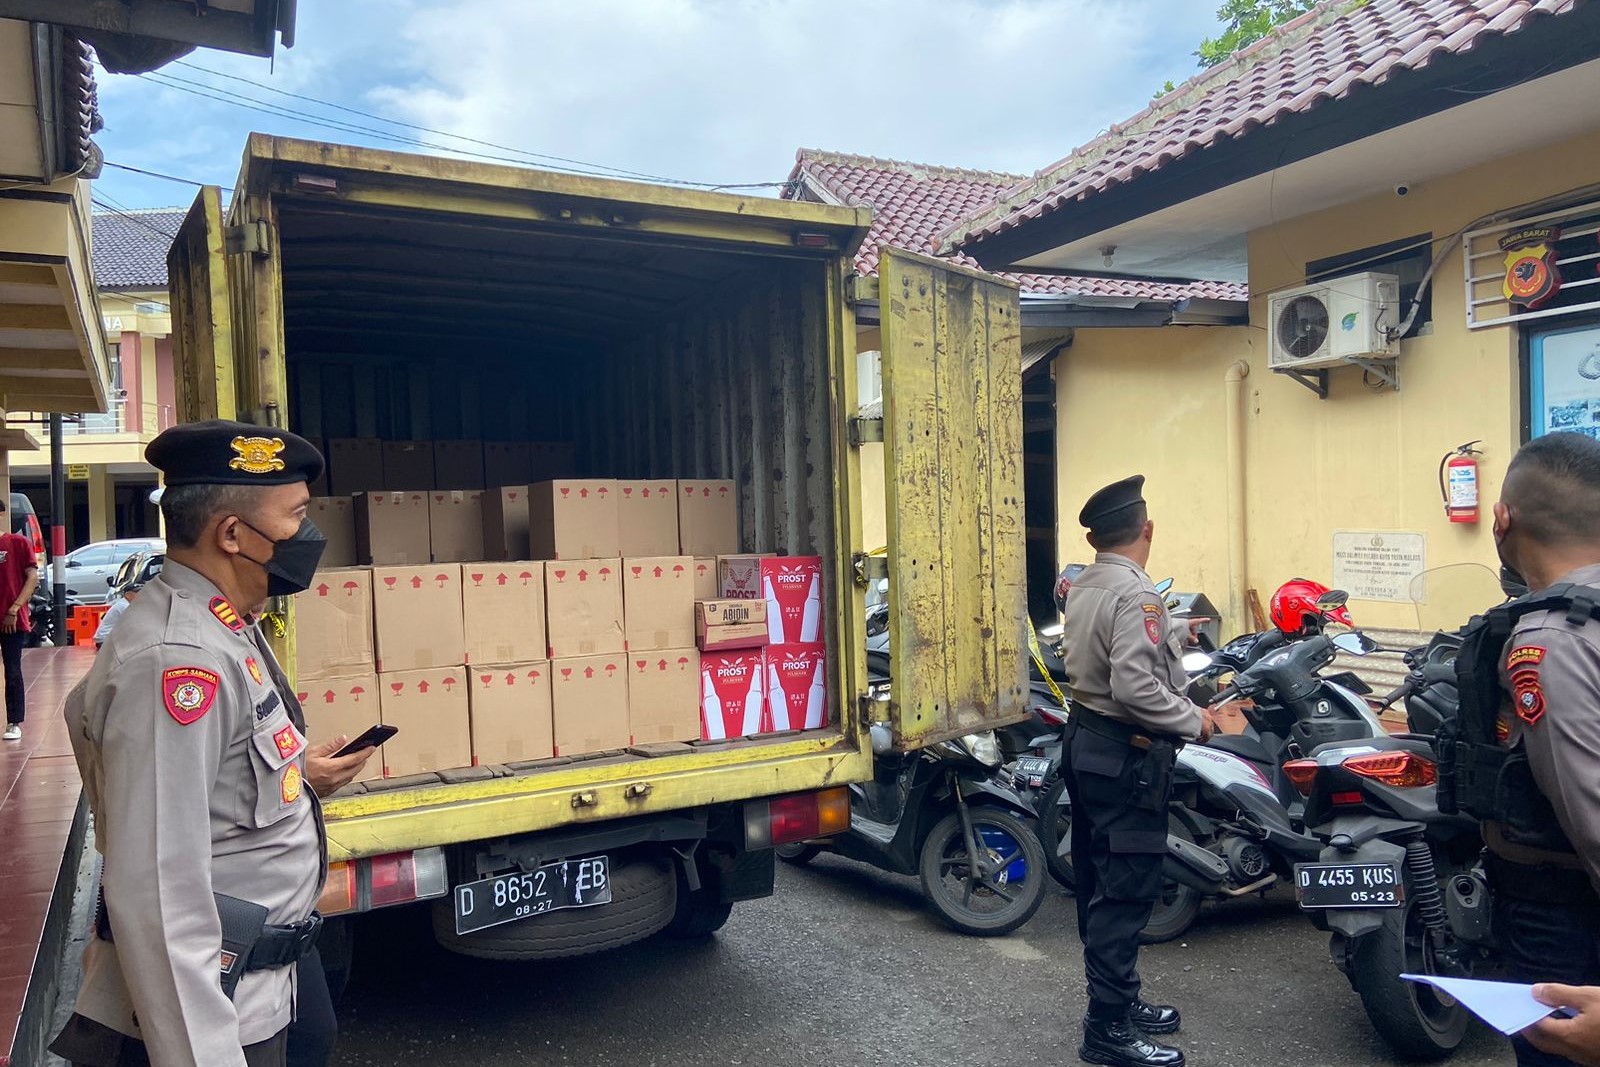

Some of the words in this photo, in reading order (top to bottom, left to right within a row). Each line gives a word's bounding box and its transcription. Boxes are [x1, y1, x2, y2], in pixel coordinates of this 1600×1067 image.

[1523, 229, 1550, 237] BARAT
[777, 574, 806, 583] PROST
[723, 607, 749, 621] ABIDIN
[782, 660, 811, 670] PROST
[717, 666, 748, 677] PROST
[1301, 871, 1310, 887] D
[1318, 869, 1355, 887] 4455
[1362, 868, 1394, 888] KUS
[460, 888, 474, 916] D
[494, 871, 547, 907] 8652
